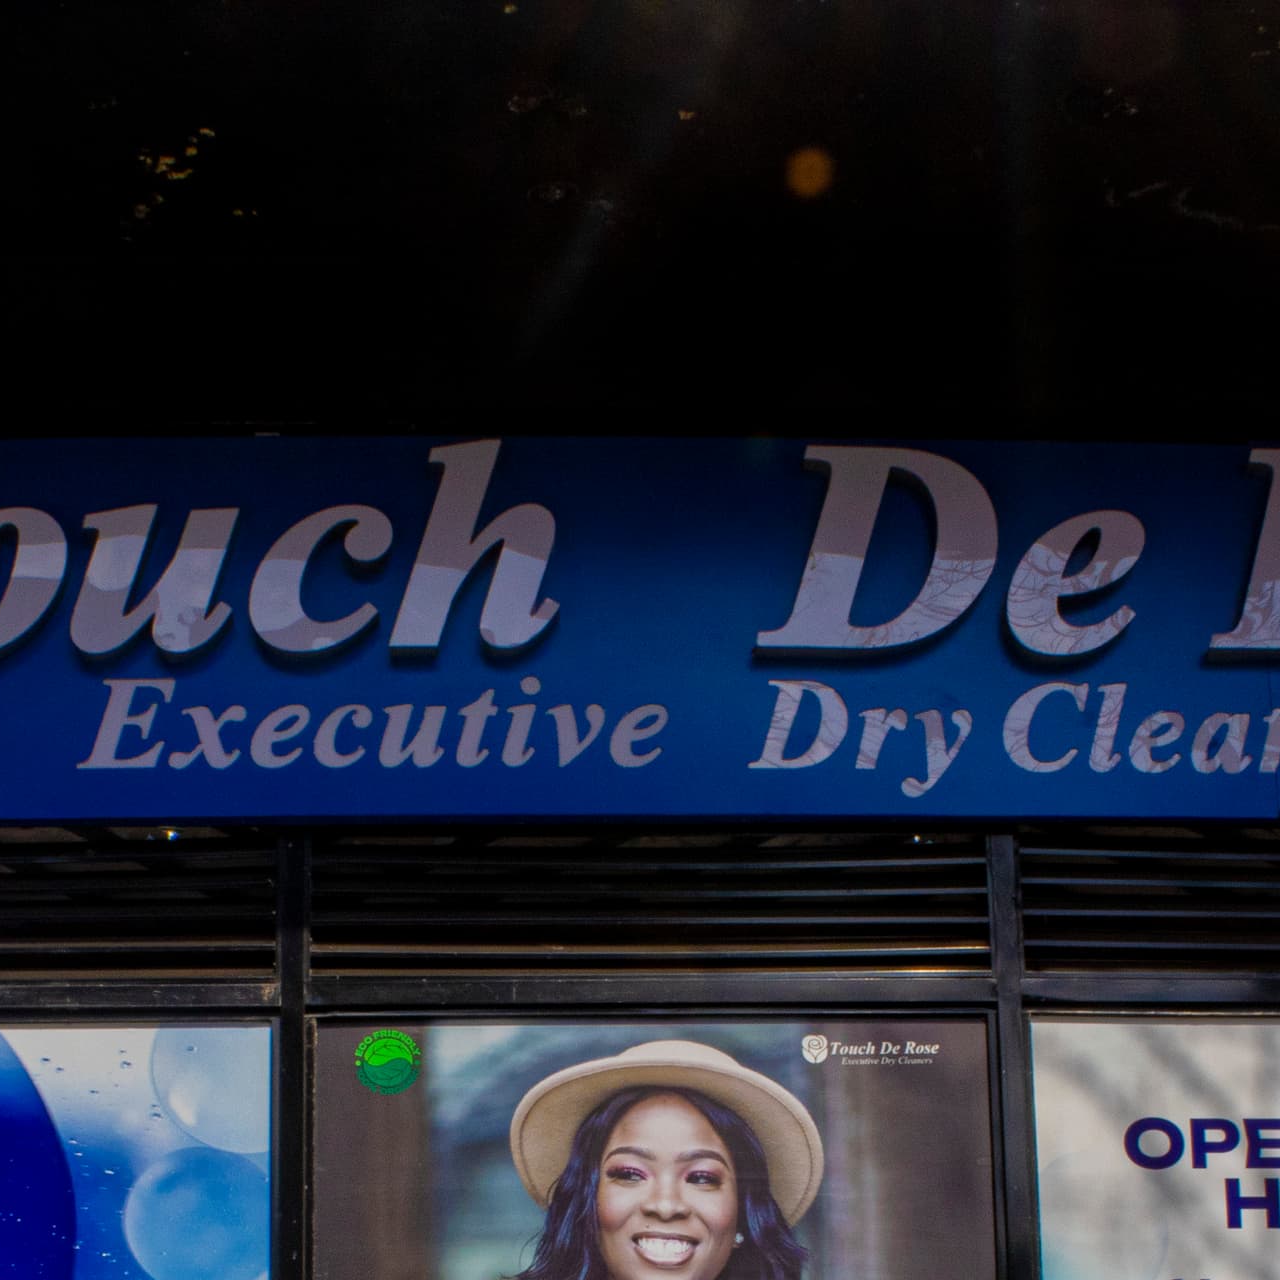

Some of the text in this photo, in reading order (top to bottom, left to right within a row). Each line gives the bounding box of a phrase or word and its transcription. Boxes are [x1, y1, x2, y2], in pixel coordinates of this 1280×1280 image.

[753, 444, 1147, 660] De
[76, 675, 670, 770] Executive
[747, 679, 973, 798] Dry
[354, 1035, 373, 1057] ECO
[830, 1040, 940, 1056] Touch De Rose
[841, 1056, 933, 1066] Executive Dry Cleaners
